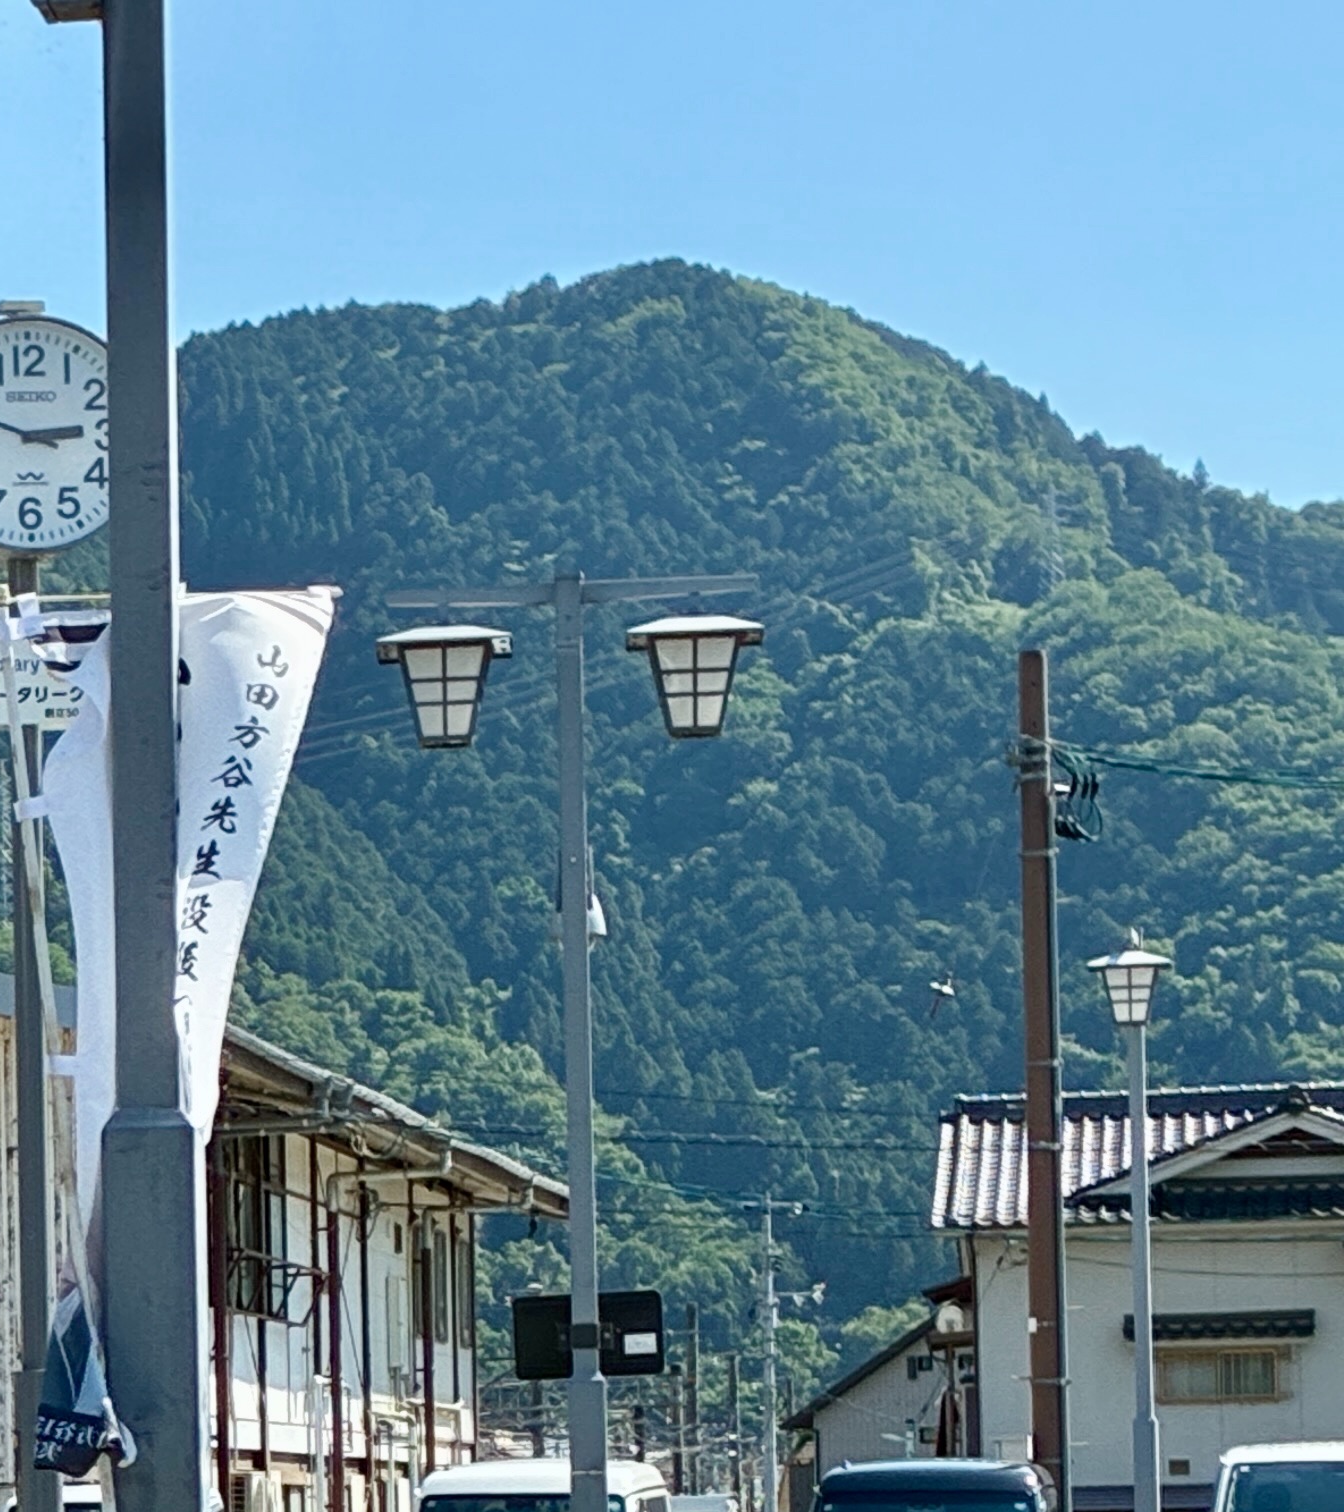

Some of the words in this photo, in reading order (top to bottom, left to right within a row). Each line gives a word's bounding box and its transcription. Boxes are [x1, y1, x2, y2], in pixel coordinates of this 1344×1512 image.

[12, 344, 46, 377] 12
[64, 352, 71, 385] 1
[5, 390, 57, 403] SEIKO
[83, 378, 108, 411] 2
[83, 456, 109, 490] 4
[18, 497, 43, 530] 6
[57, 486, 81, 519] 5
